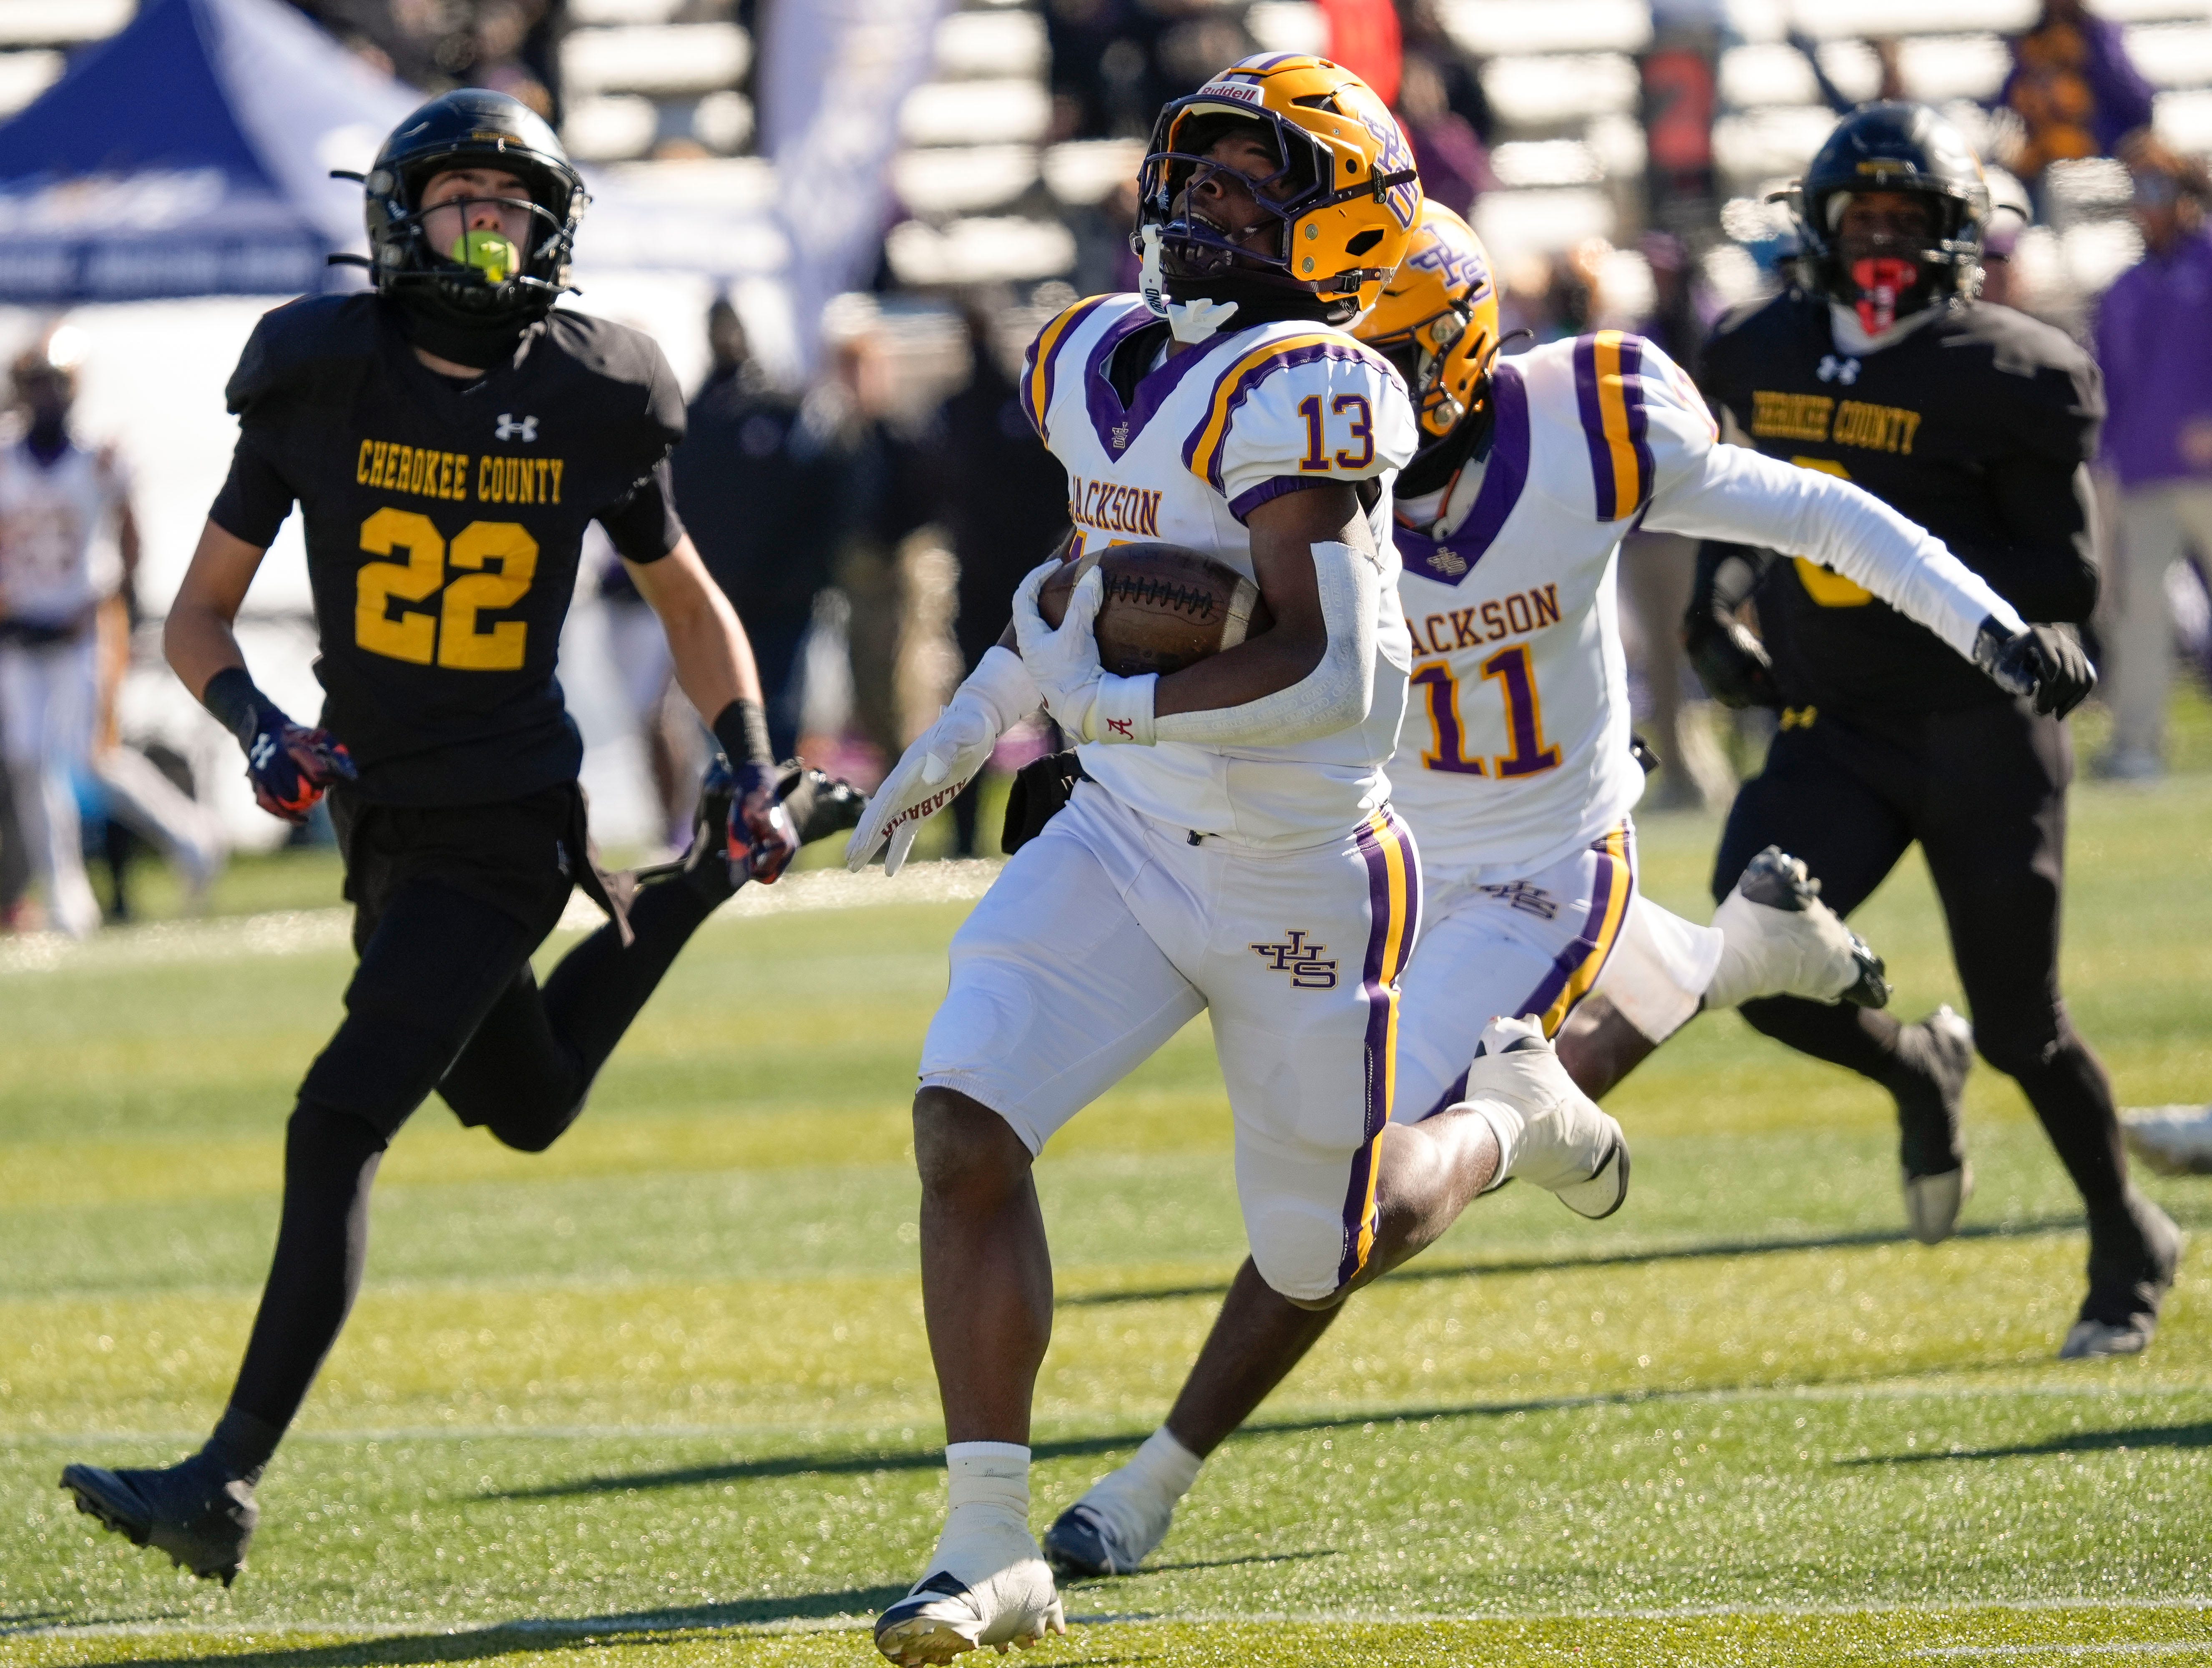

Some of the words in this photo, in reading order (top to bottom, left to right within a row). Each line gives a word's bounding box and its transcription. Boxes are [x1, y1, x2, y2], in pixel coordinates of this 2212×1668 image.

[1202, 85, 1257, 101] Riddell
[1297, 394, 1376, 472] 13
[357, 439, 470, 502] CHEROKEE
[478, 455, 564, 505] COUNTY
[355, 506, 540, 672] 22
[1405, 582, 1562, 658] ACKSON
[1410, 641, 1563, 780] 11
[881, 776, 968, 838] ALABAMA
